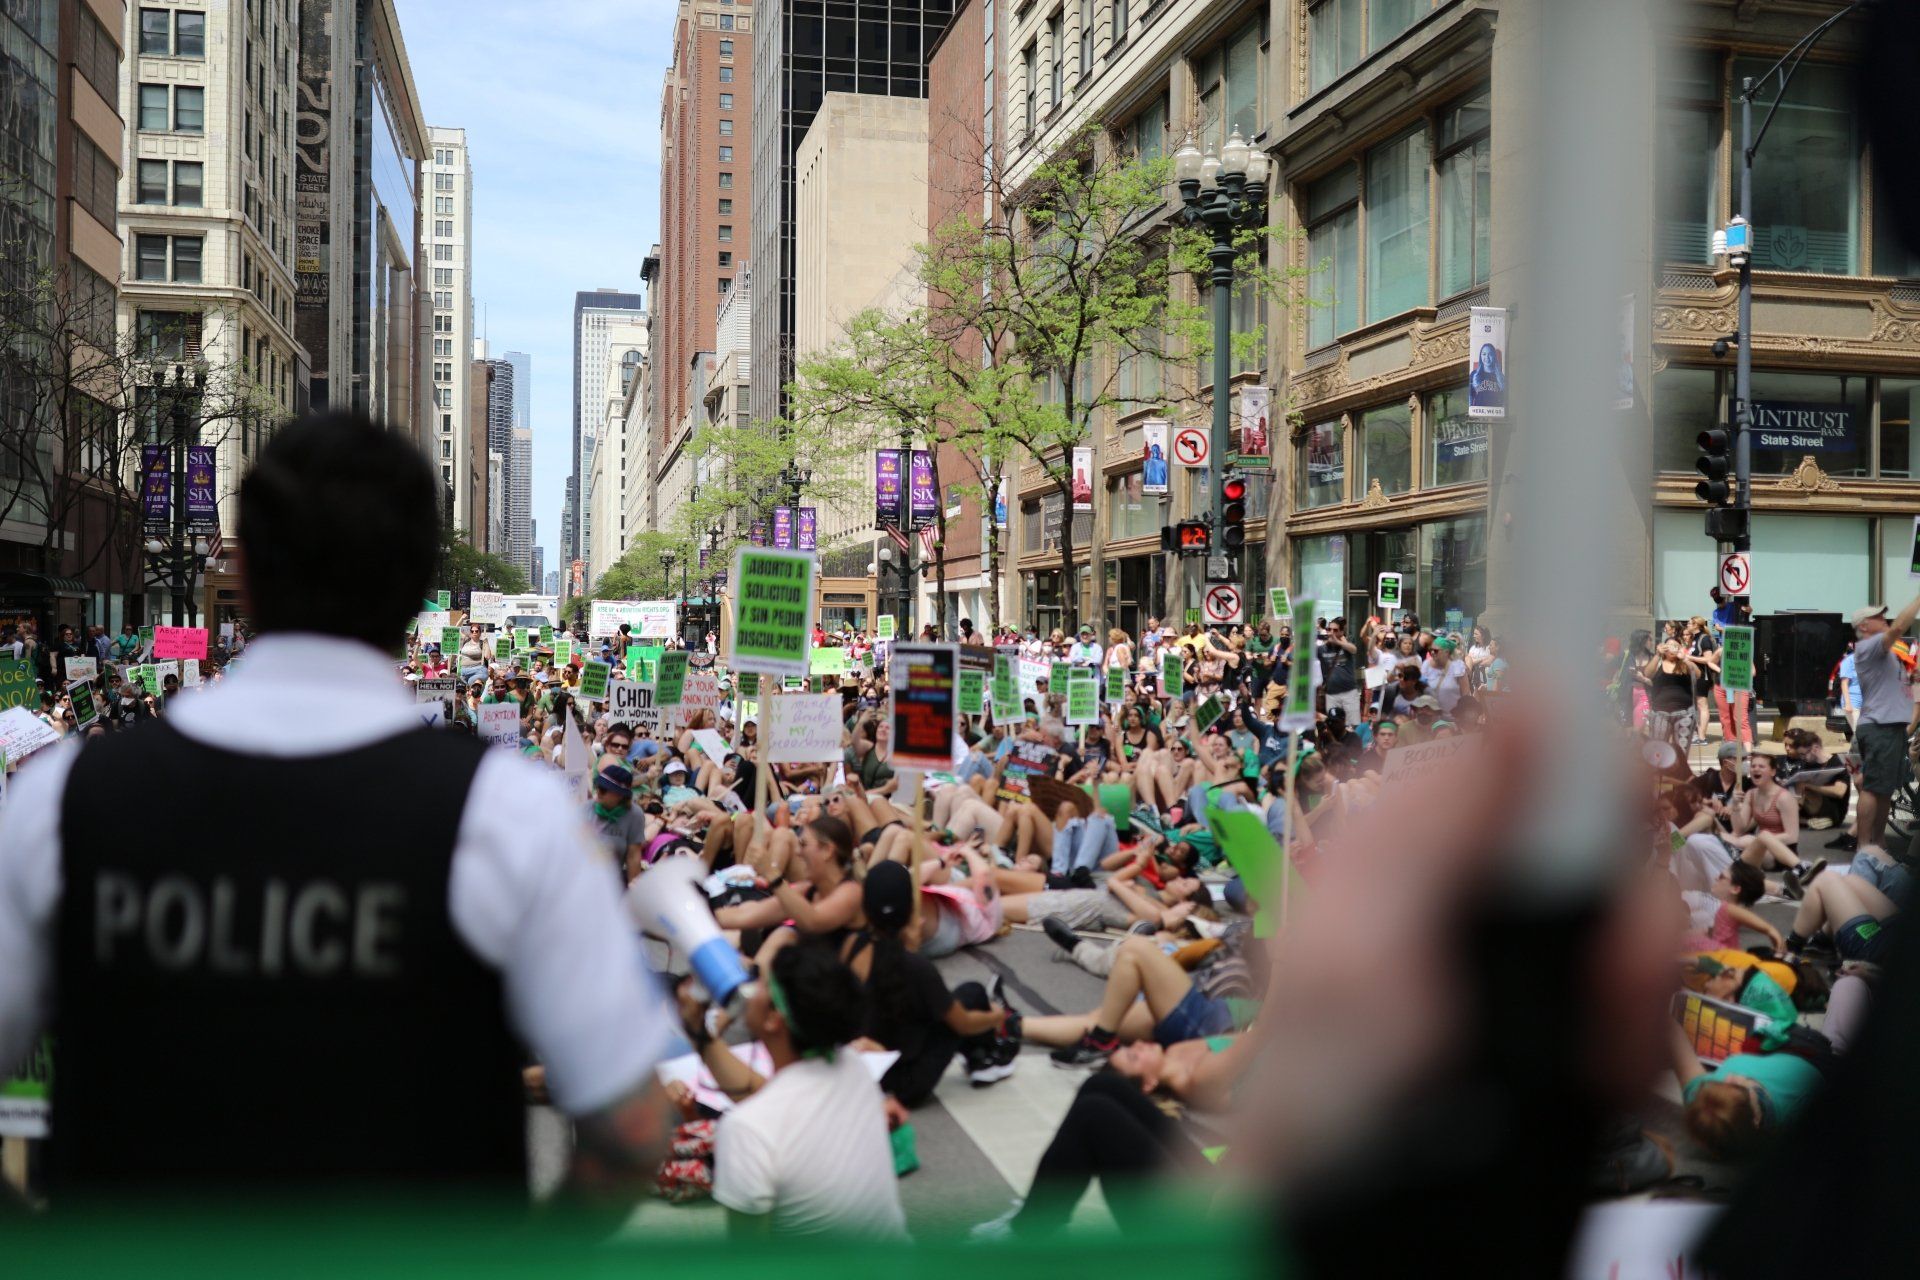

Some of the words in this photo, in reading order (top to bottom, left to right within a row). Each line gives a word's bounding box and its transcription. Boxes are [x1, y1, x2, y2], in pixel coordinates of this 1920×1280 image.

[298, 225, 320, 235] CHOICE
[298, 235, 319, 245] SPACE
[1820, 427, 1846, 437] BANK
[1760, 434, 1790, 446] State
[1791, 435, 1824, 447] Street
[1454, 445, 1470, 457] State
[159, 628, 202, 636] ABORTION
[420, 683, 437, 691] HELL
[440, 683, 453, 691] NO!
[484, 709, 516, 722] ABORTION
[614, 709, 625, 718] NO
[629, 709, 658, 719] WOMAN
[502, 732, 518, 745] CARE
[96, 873, 404, 976] POLICE
